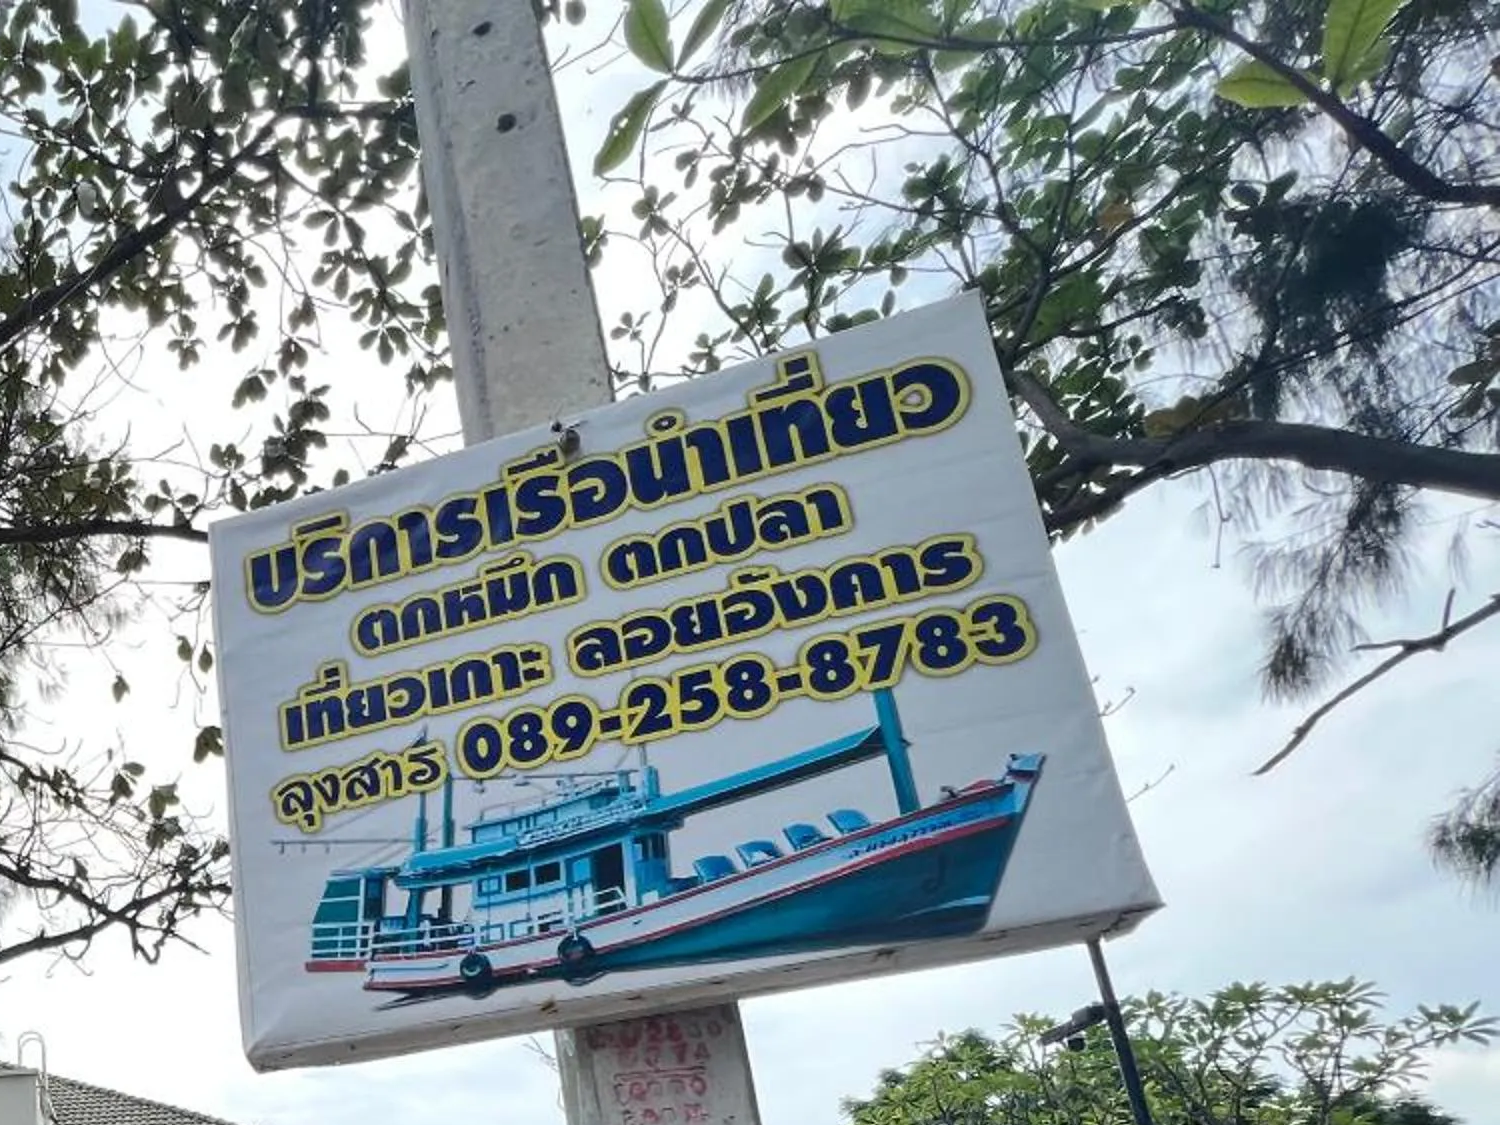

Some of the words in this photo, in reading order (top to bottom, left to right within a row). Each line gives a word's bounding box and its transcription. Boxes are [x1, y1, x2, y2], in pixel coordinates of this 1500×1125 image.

[247, 353, 966, 610] บริการเรือนำเที่ยว
[353, 554, 584, 654] ตกหมึก
[604, 486, 848, 588] ตกปลา
[282, 646, 550, 748] เที่ยวเกาะ
[569, 538, 978, 674] ลอยอังคาร
[459, 596, 1030, 776] 089-258-8783
